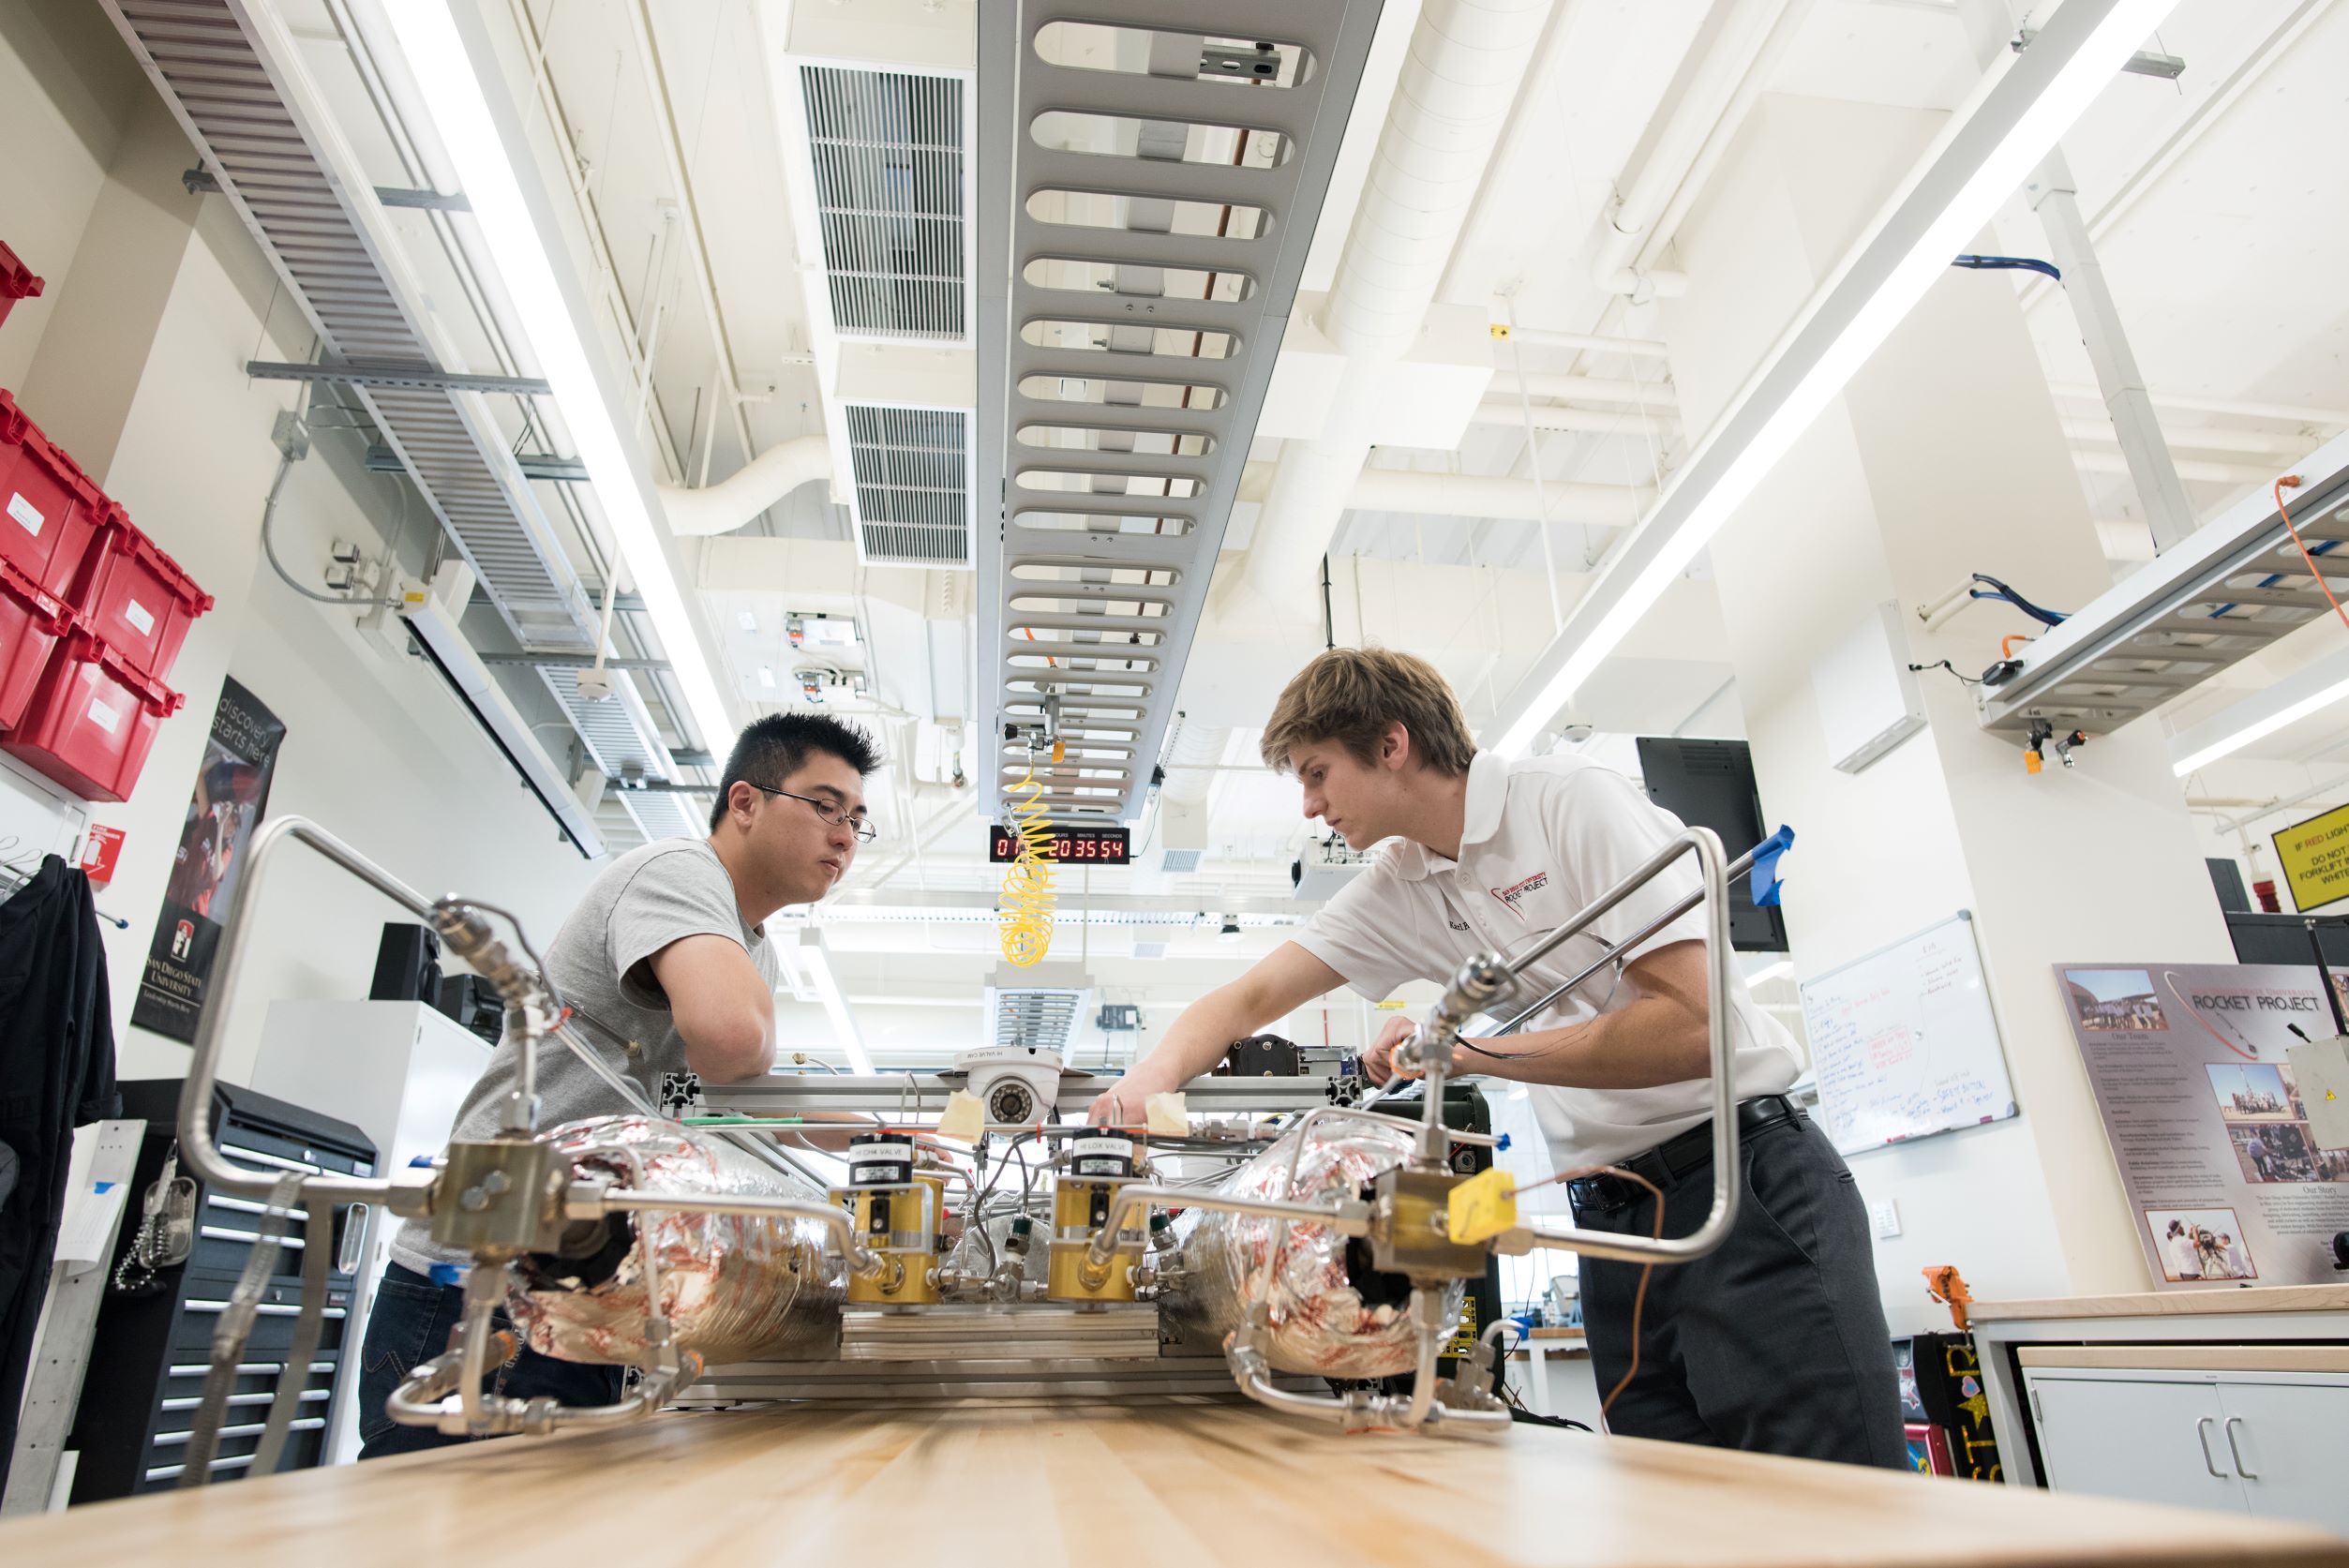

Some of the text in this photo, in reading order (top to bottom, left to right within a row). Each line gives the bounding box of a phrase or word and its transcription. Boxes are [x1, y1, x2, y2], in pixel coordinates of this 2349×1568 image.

[218, 697, 271, 748] discovery
[212, 715, 271, 769] starts here
[1075, 840, 1096, 858] 35
[1100, 841, 1123, 858] 54
[2295, 842, 2303, 852] IF
[2305, 834, 2325, 848] RED
[2312, 845, 2346, 866] DO NOT
[2299, 859, 2342, 882] FORKLIFT
[1524, 877, 1549, 892] PROJECT
[151, 970, 191, 996] UNIVERSITY
[2192, 994, 2320, 1011] ROCKET PROJECT
[879, 1147, 902, 1156] VALVE
[1104, 1142, 1127, 1151] VALVE
[2302, 1185, 2337, 1194] Our Story
